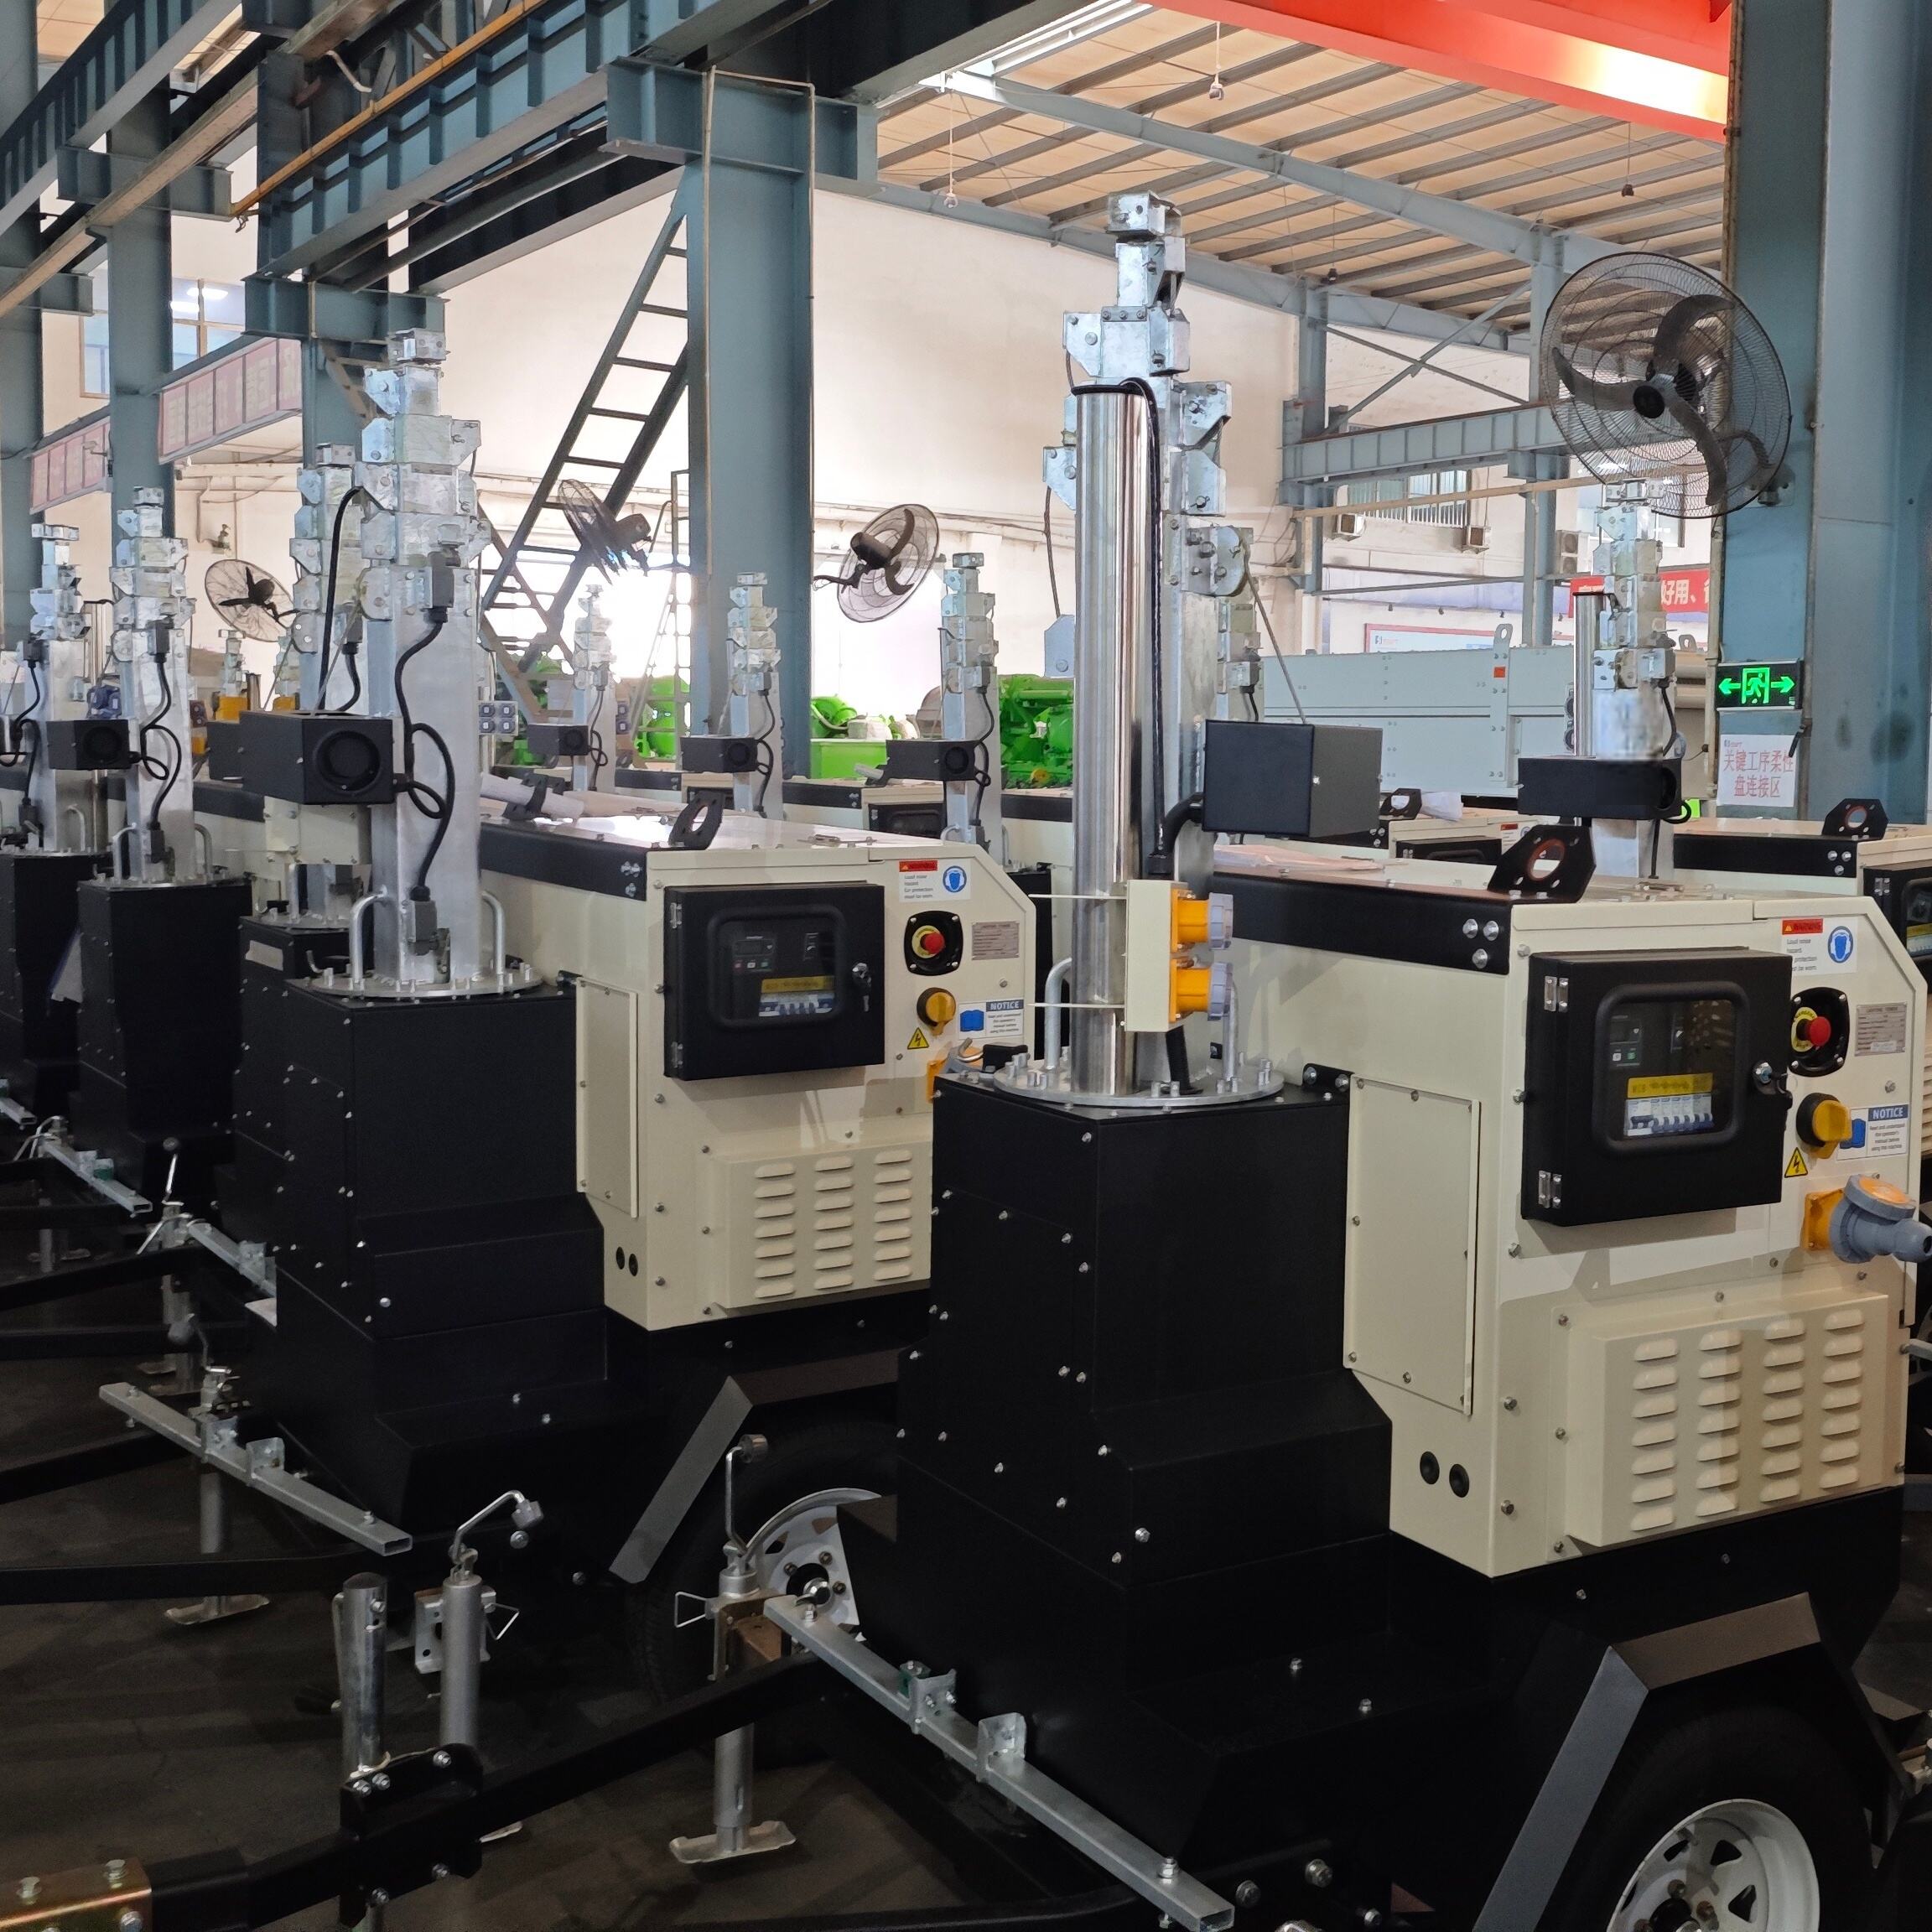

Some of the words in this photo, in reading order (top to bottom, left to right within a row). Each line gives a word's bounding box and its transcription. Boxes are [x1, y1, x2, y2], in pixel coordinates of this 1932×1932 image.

[1723, 750, 1794, 771] 关键工序柔性
[1734, 774, 1781, 797] 盘连接区
[990, 1000, 1020, 1010] NOTICE
[1872, 1107, 1903, 1119] NOTICE
